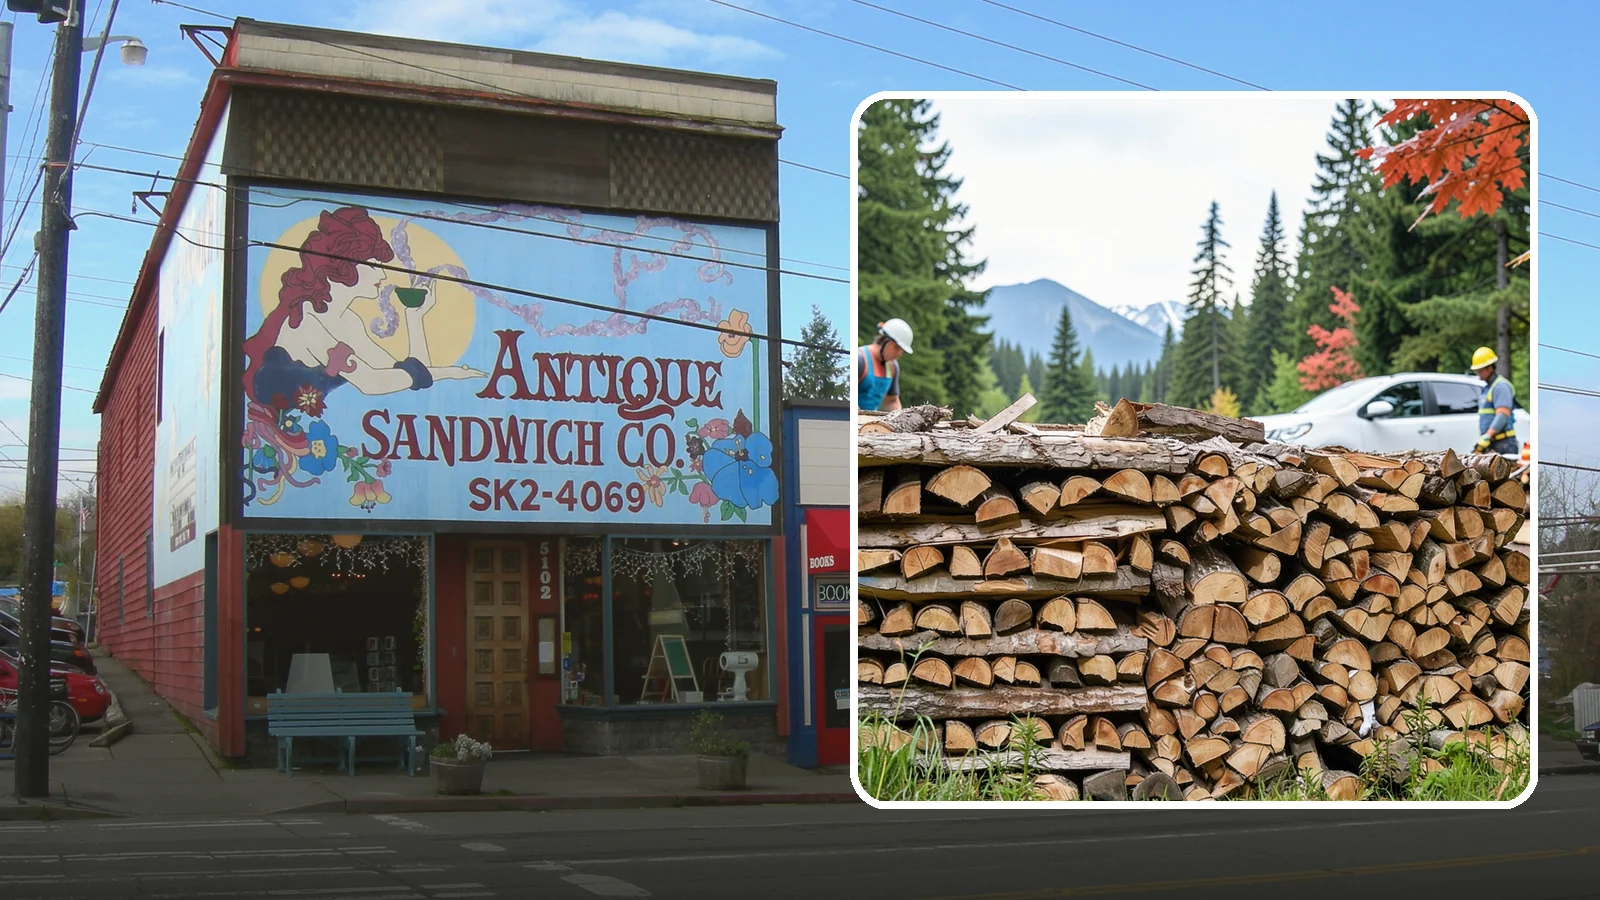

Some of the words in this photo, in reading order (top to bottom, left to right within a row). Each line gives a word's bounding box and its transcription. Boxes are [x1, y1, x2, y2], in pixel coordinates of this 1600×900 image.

[475, 329, 723, 421] ANTIQUE
[361, 408, 604, 467] SANDWICH
[617, 422, 685, 469] CO.
[468, 478, 645, 514] SK2-4069
[540, 541, 551, 600] 5102
[809, 555, 835, 569] BOOKS
